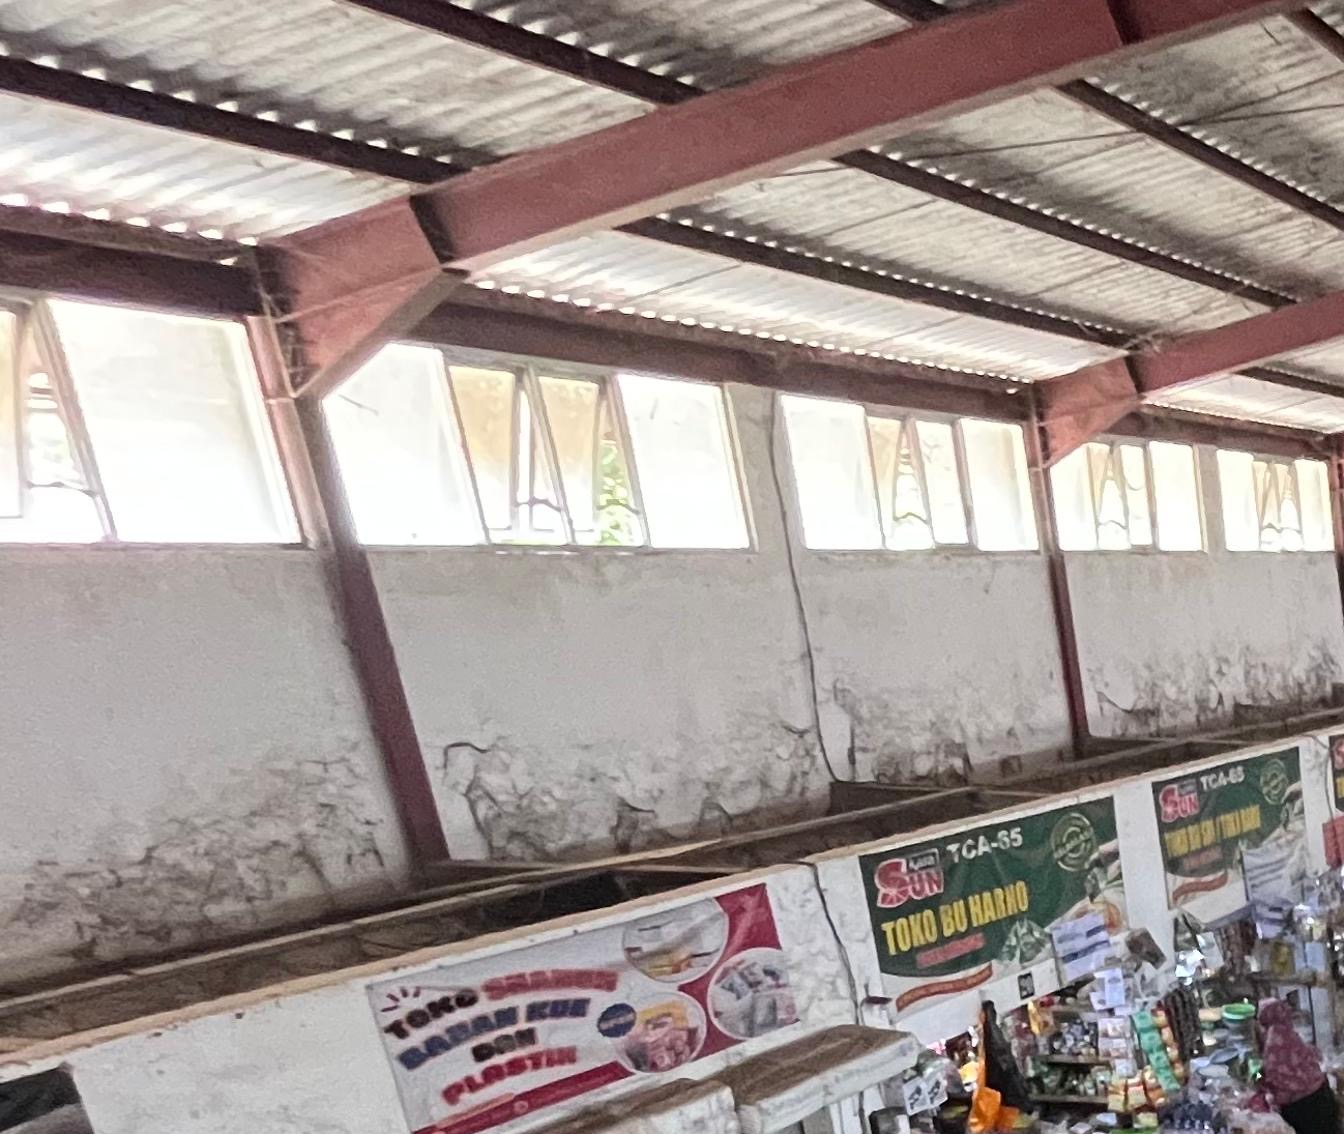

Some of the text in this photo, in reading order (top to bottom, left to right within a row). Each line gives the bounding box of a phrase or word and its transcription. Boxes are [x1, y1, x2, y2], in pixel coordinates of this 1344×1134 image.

[947, 828, 1022, 862] TCA-65
[876, 859, 943, 907] SUN
[882, 910, 937, 954] TOKO
[939, 902, 967, 937] BU
[383, 987, 479, 1040] TOKO
[399, 1007, 517, 1070] BAHAN
[526, 998, 589, 1022] KUE
[472, 1028, 535, 1062] DAN
